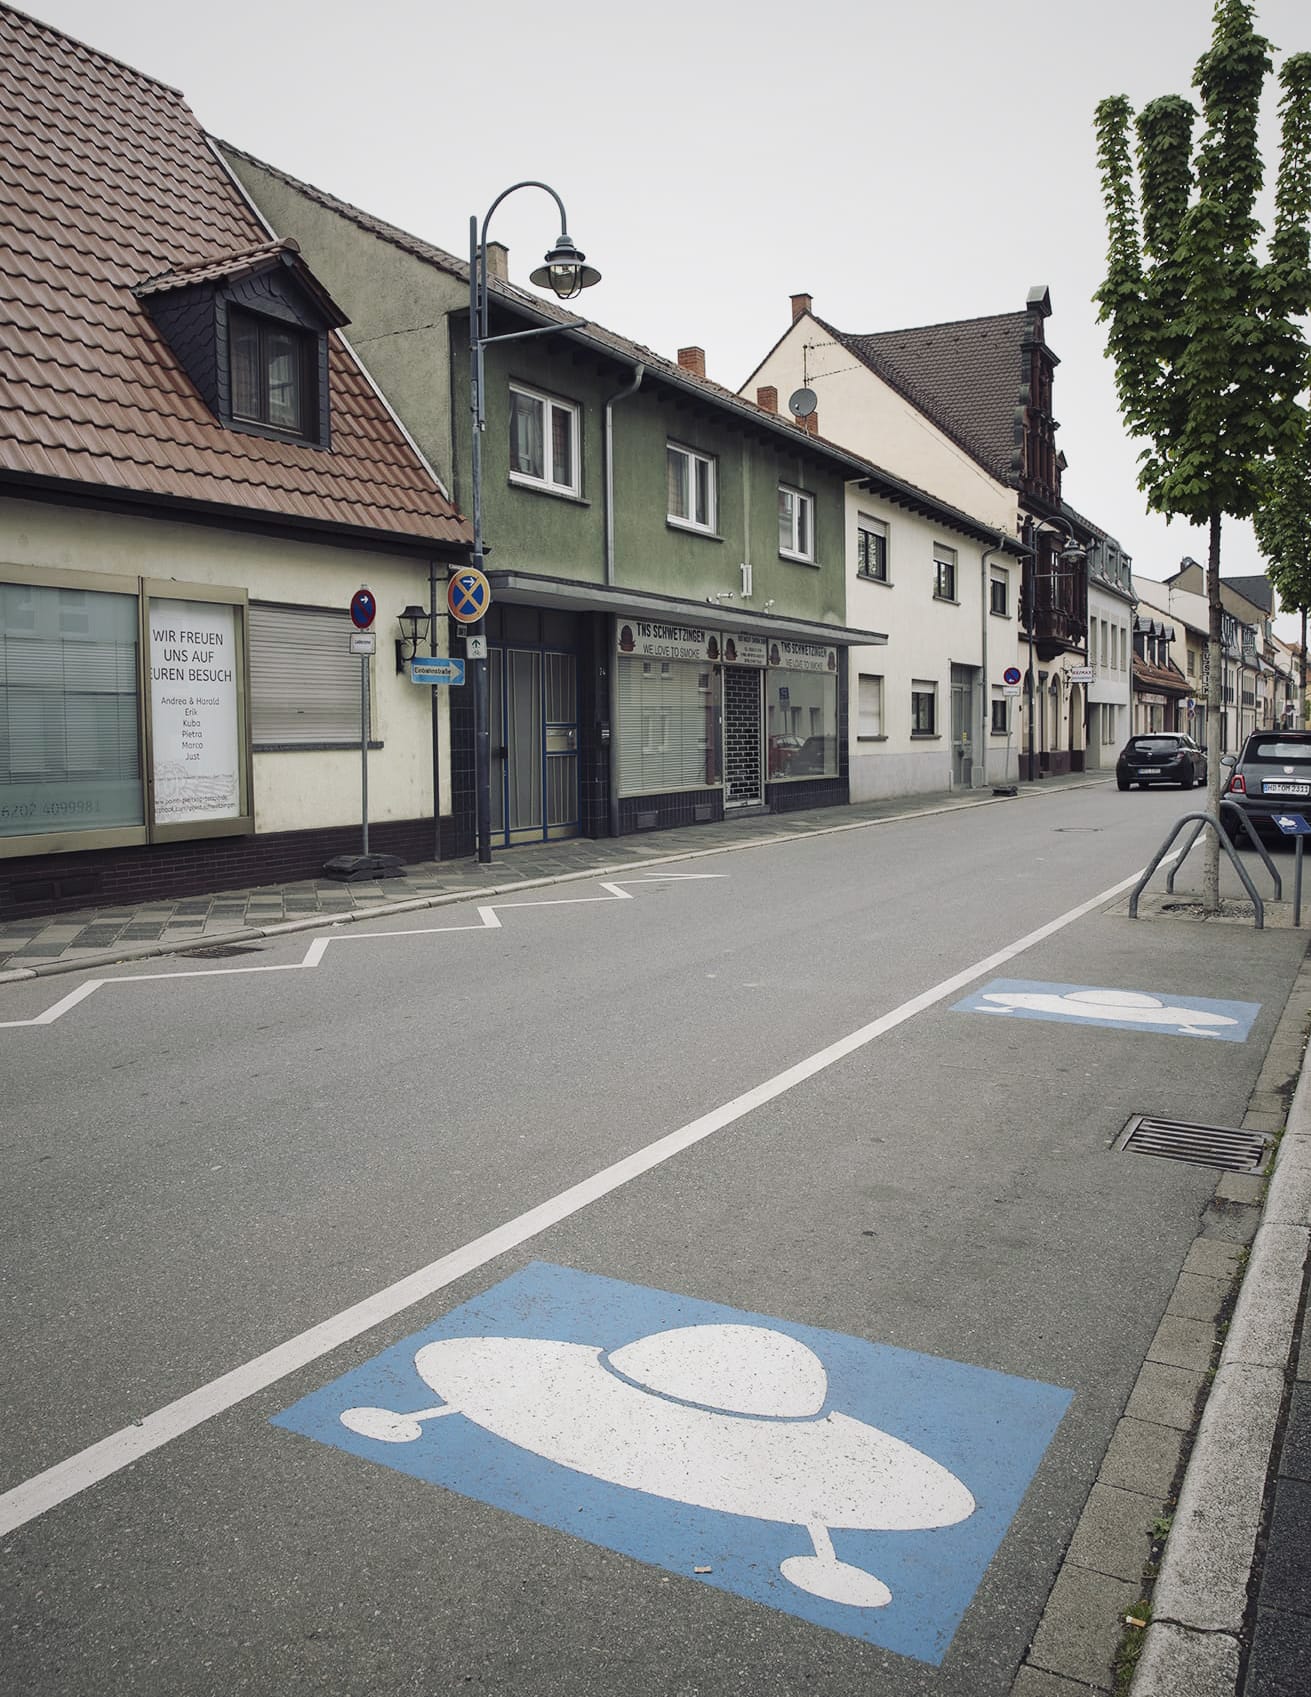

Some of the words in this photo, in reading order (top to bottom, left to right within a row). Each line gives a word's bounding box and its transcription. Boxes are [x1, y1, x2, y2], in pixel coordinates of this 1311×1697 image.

[152, 629, 176, 643] WIR
[180, 631, 223, 646] FREUEN
[653, 625, 706, 643] SCHWETZINGEN
[163, 649, 188, 662] UNS
[191, 650, 214, 663] AUF
[643, 644, 654, 654] WE
[655, 645, 670, 656] LOVE
[671, 647, 679, 658] TO
[680, 648, 700, 659] SMOKE
[188, 668, 232, 682] BESUCH
[161, 697, 187, 706] Andrea
[188, 698, 194, 706] &
[185, 708, 198, 717] Erik
[183, 719, 201, 728] Kuba
[182, 741, 204, 750] Marco
[185, 752, 201, 761] Just
